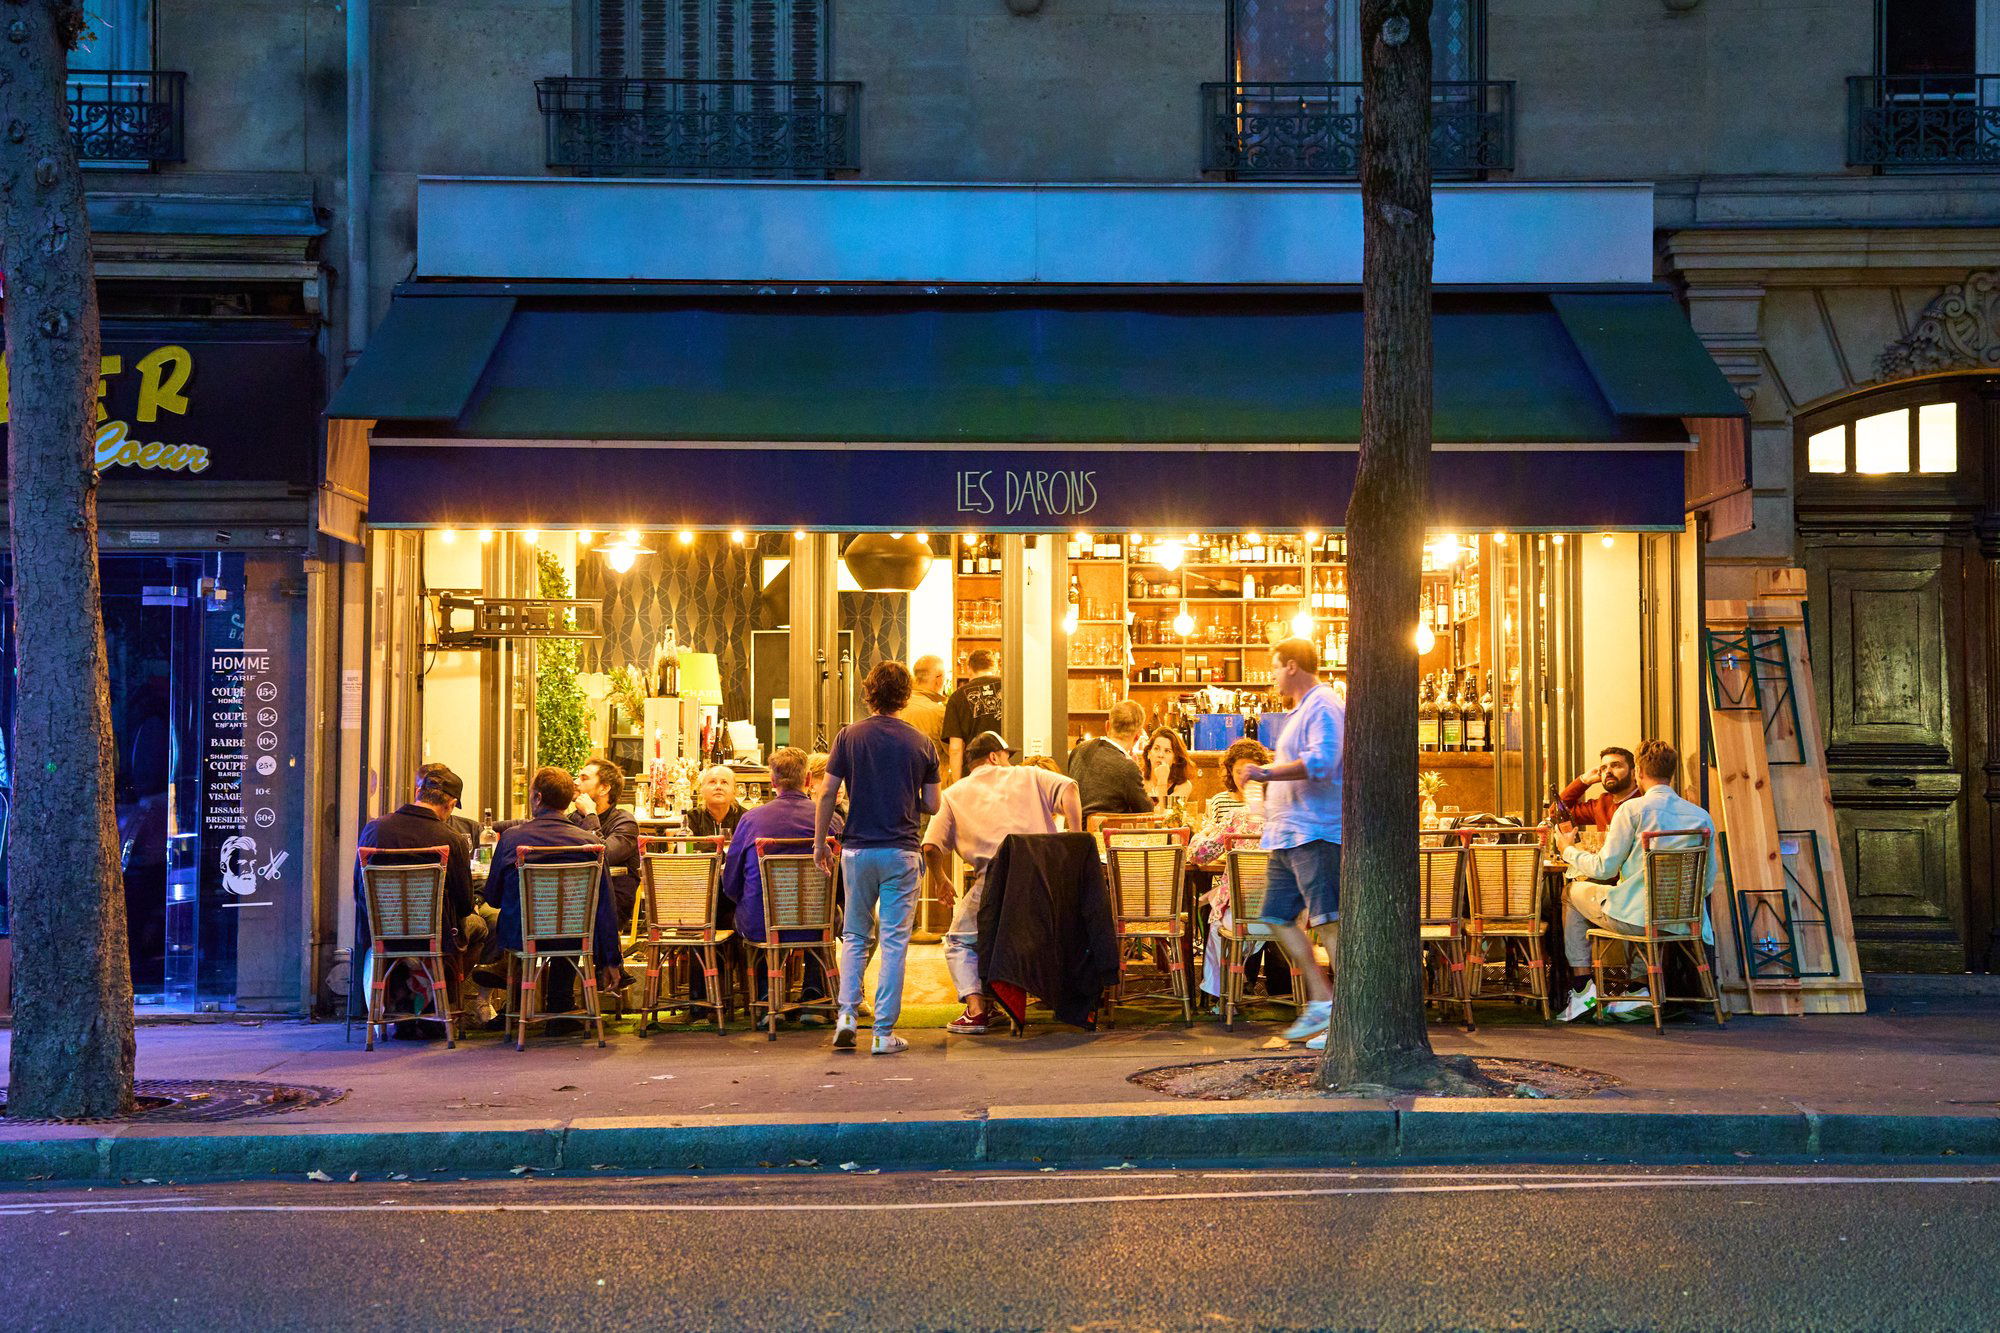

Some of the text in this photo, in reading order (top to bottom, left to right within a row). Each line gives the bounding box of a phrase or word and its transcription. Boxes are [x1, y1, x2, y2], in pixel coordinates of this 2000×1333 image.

[95, 420, 209, 473] Coeur
[957, 470, 1098, 515] LES DARONS
[212, 656, 270, 670] HOMME
[211, 687, 275, 697] COUPE 15€
[212, 712, 276, 721] COUPE 12€
[210, 737, 275, 747] BARBE 10€
[210, 761, 247, 771] COUPE
[210, 782, 240, 791] SOINS
[208, 793, 242, 801] VISAGE
[210, 806, 245, 814] LISSAGE
